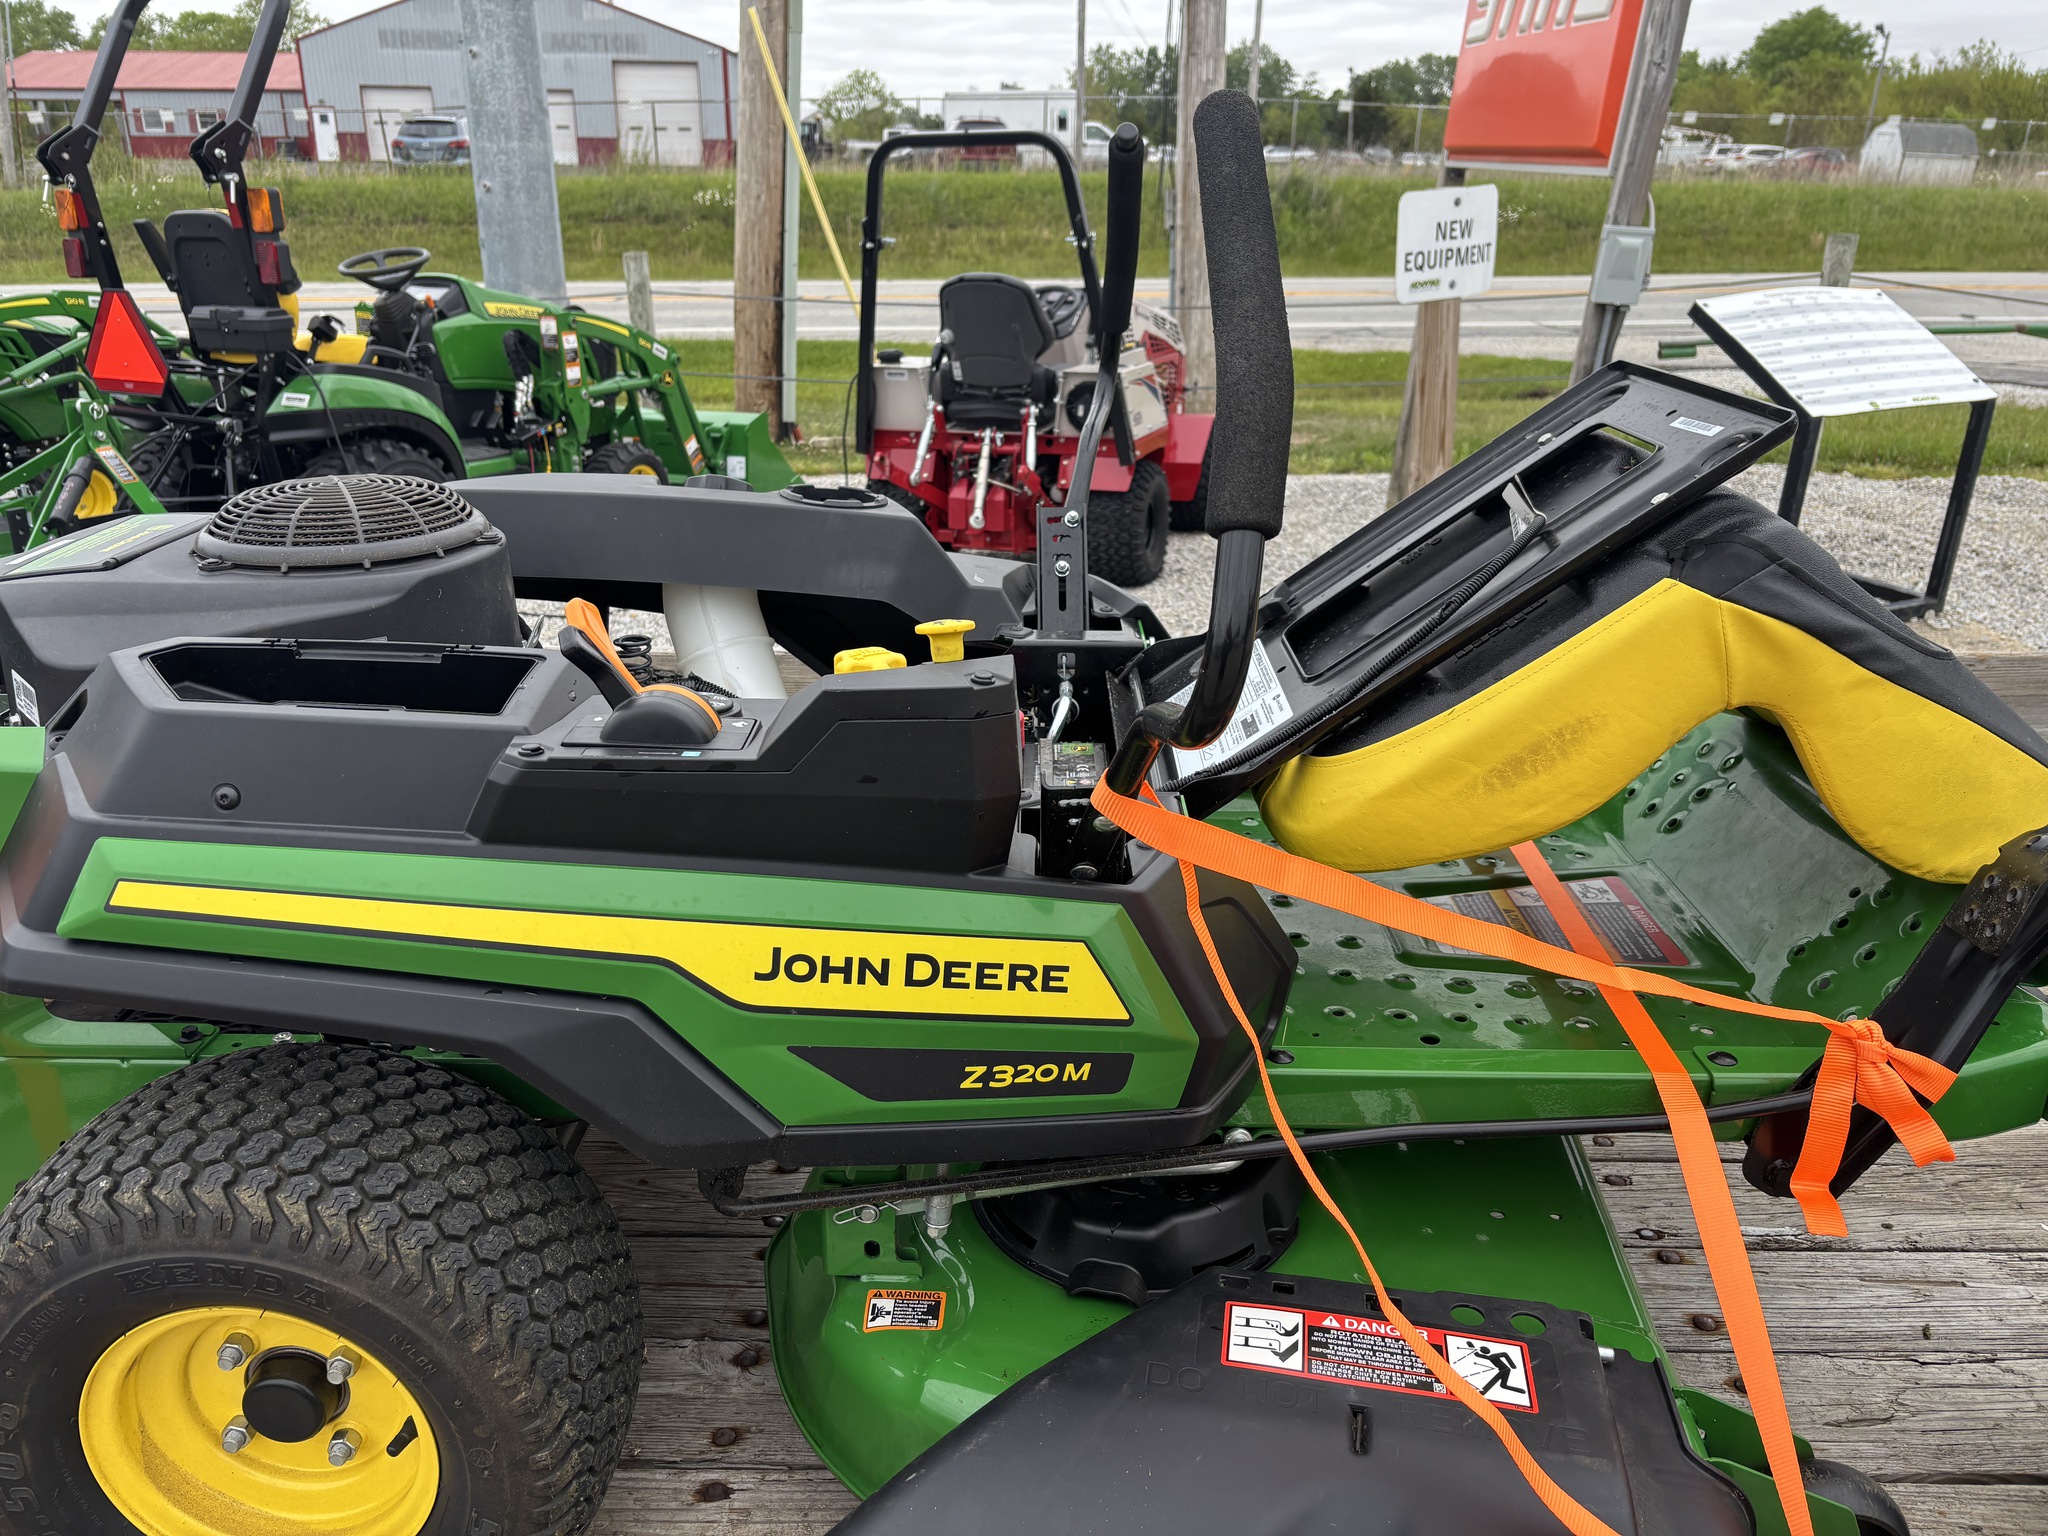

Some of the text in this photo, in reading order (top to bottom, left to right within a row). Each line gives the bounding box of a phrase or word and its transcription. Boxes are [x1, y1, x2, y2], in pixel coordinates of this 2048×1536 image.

[1436, 218, 1474, 242] NEW
[1404, 243, 1492, 272] EQUIPMENT
[1631, 910, 1659, 932] DANGER
[754, 947, 1070, 993] JOHN DEERE
[114, 1262, 332, 1315] KENDA
[12, 1328, 33, 1349] PLY
[29, 1300, 66, 1331] RATING
[1331, 1330, 1382, 1341] ROTATING
[1344, 1319, 1429, 1340] DANGR
[388, 1332, 438, 1375] NYLON
[1328, 1345, 1373, 1355] THROWN
[1376, 1352, 1423, 1363] OBJECTS
[1312, 1365, 1352, 1374] DISCHARGE
[1338, 1373, 1370, 1381] CATCHER
[1404, 1374, 1435, 1382] WITHOUT
[1143, 1360, 1597, 1456] DO NOT REMVE
